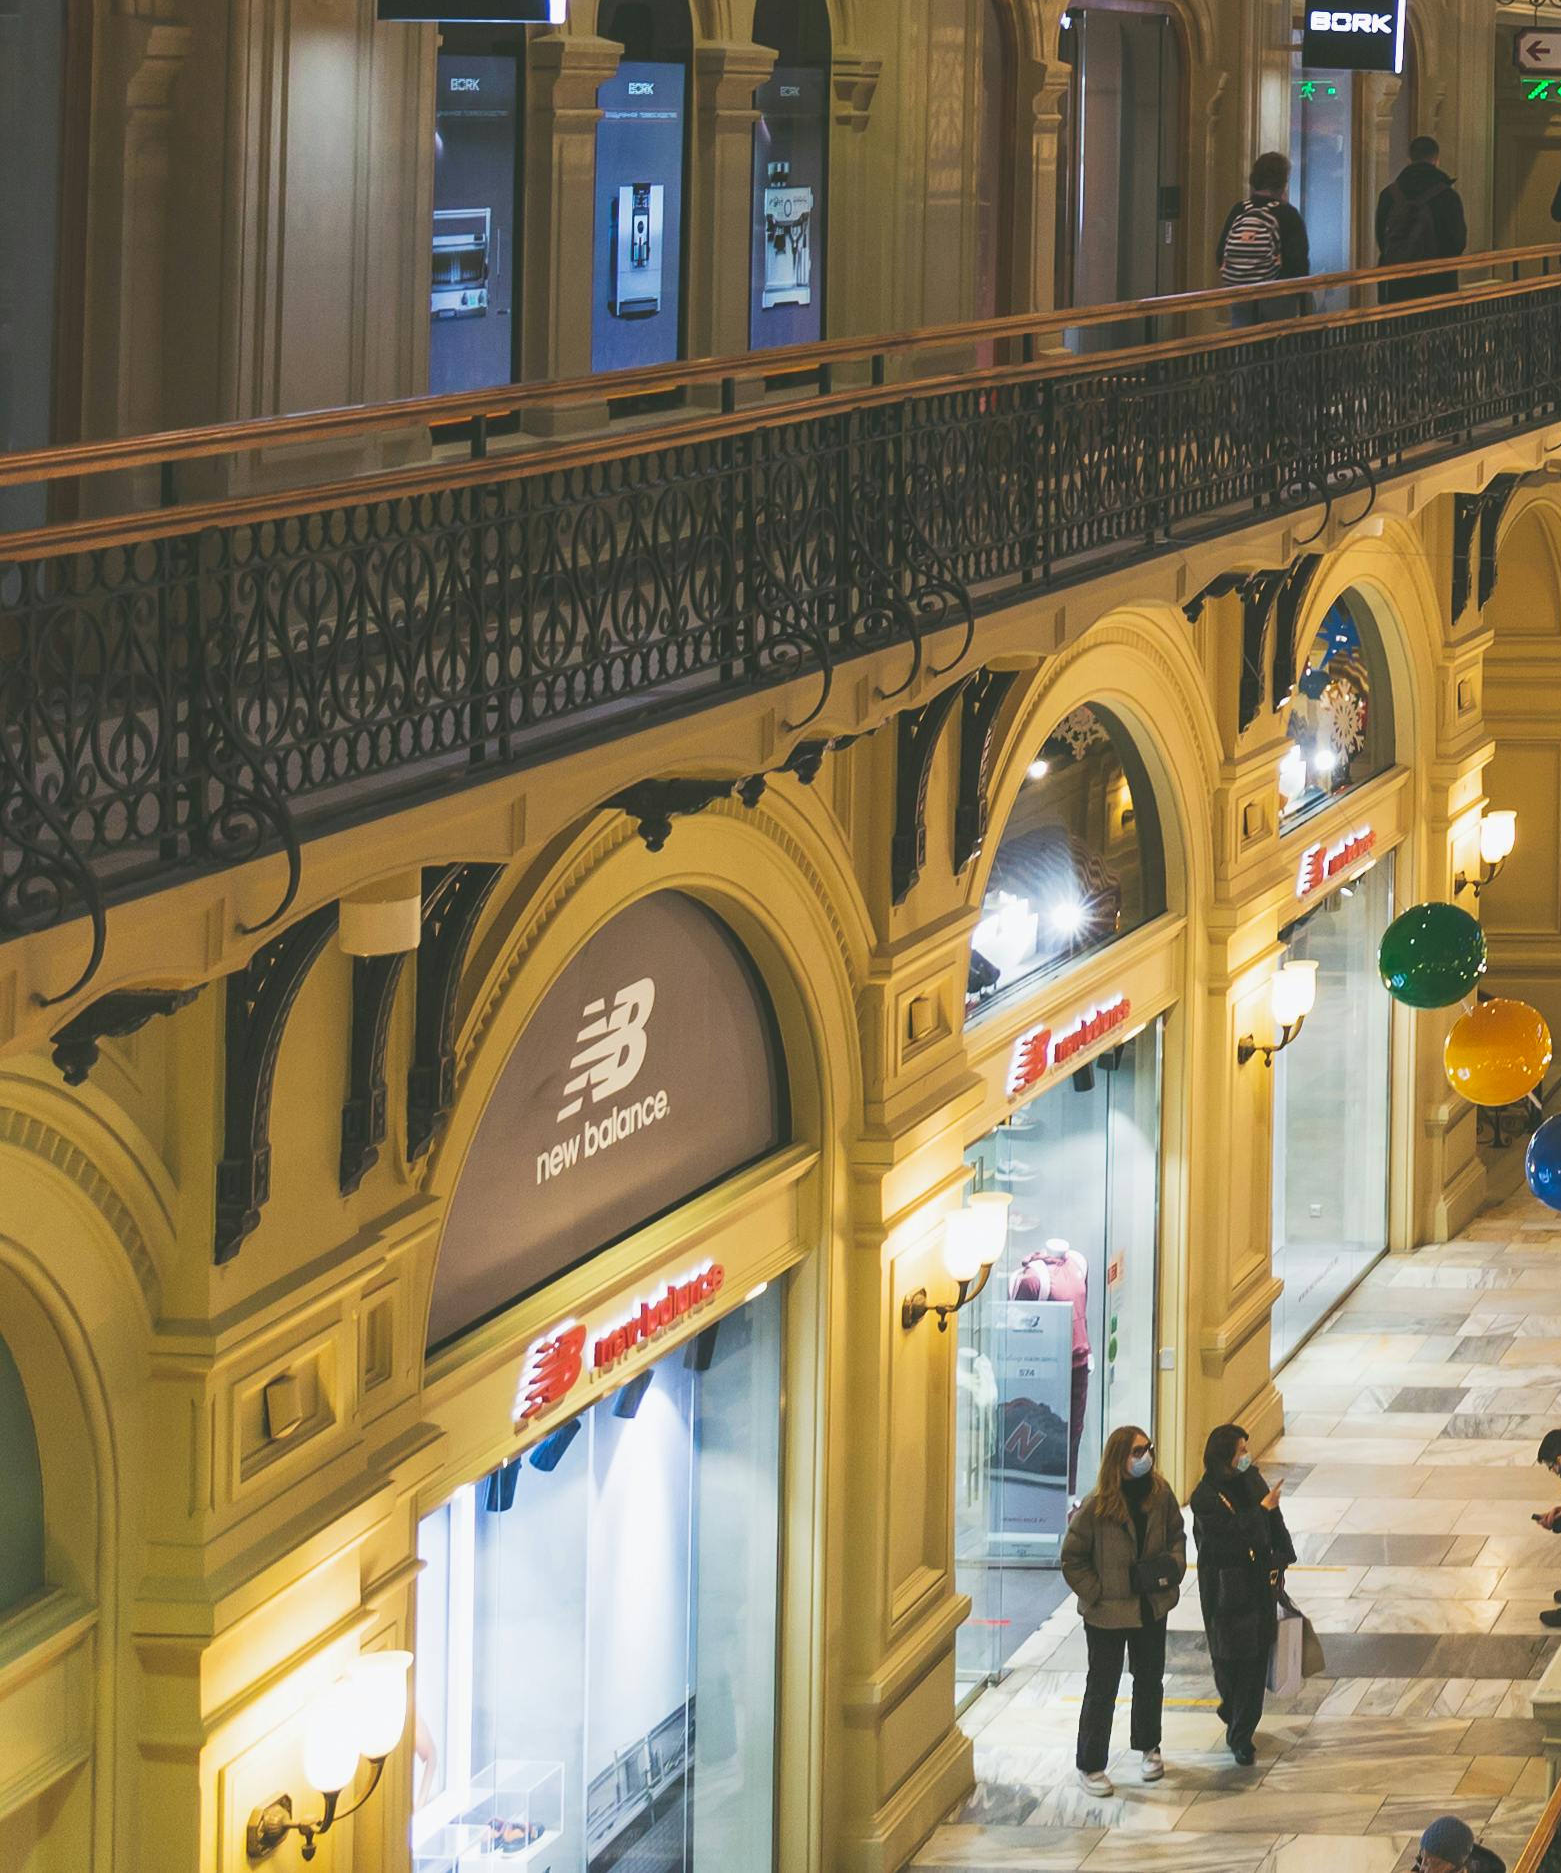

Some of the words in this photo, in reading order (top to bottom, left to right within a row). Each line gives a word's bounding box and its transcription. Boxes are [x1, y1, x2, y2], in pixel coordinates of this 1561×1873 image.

[1310, 10, 1388, 34] BORK
[450, 77, 480, 92] BORK
[628, 82, 655, 95] BORK
[536, 1134, 581, 1185] new
[584, 1089, 669, 1159] balance
